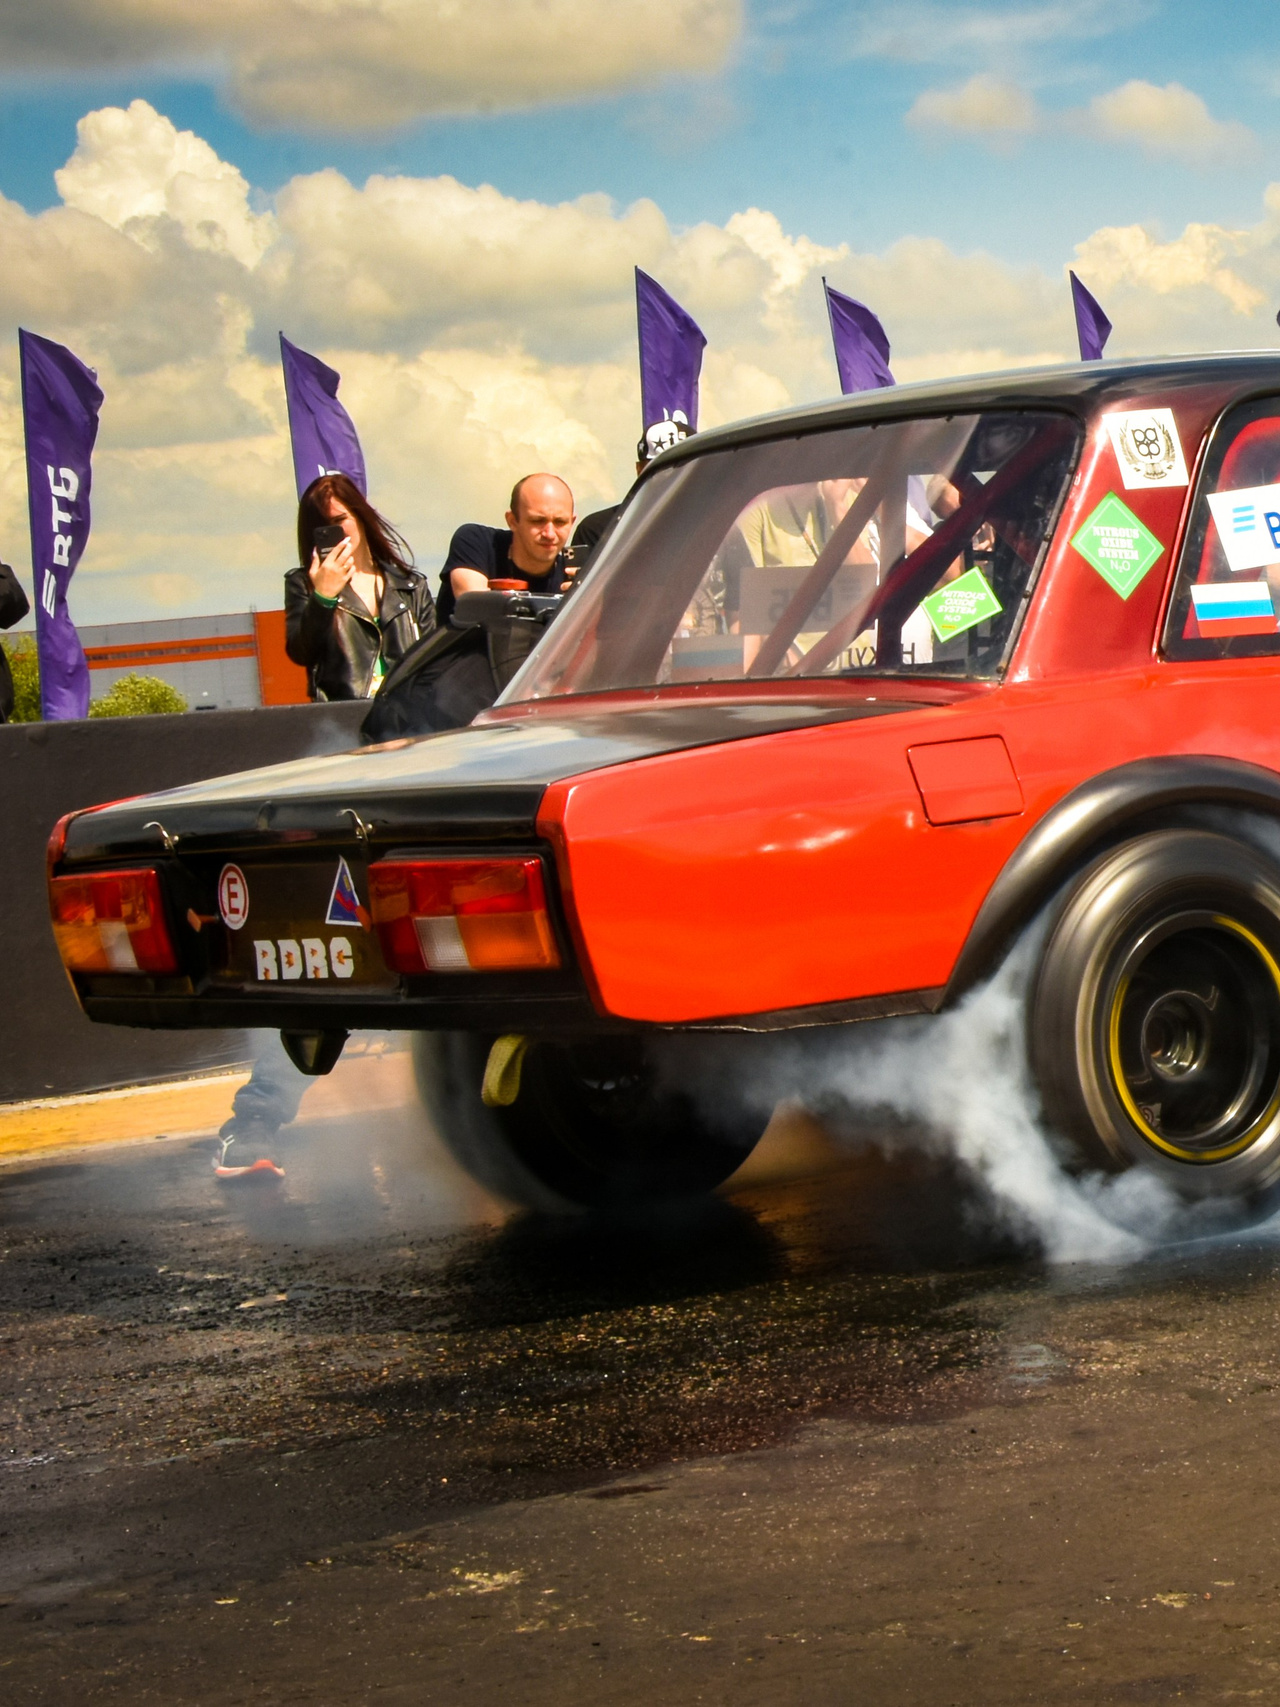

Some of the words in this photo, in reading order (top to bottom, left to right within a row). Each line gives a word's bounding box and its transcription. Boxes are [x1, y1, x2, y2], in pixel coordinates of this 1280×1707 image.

[47, 464, 79, 567] ВТБ
[1092, 526, 1140, 539] NITROUS
[1101, 537, 1134, 549] OXIDE
[1098, 547, 1140, 560] SYSTEM
[942, 590, 987, 601] NITROUS
[945, 597, 977, 607] OXIDE
[937, 604, 977, 615] SYSTEM
[227, 877, 240, 915] E
[253, 936, 354, 981] RDRC
